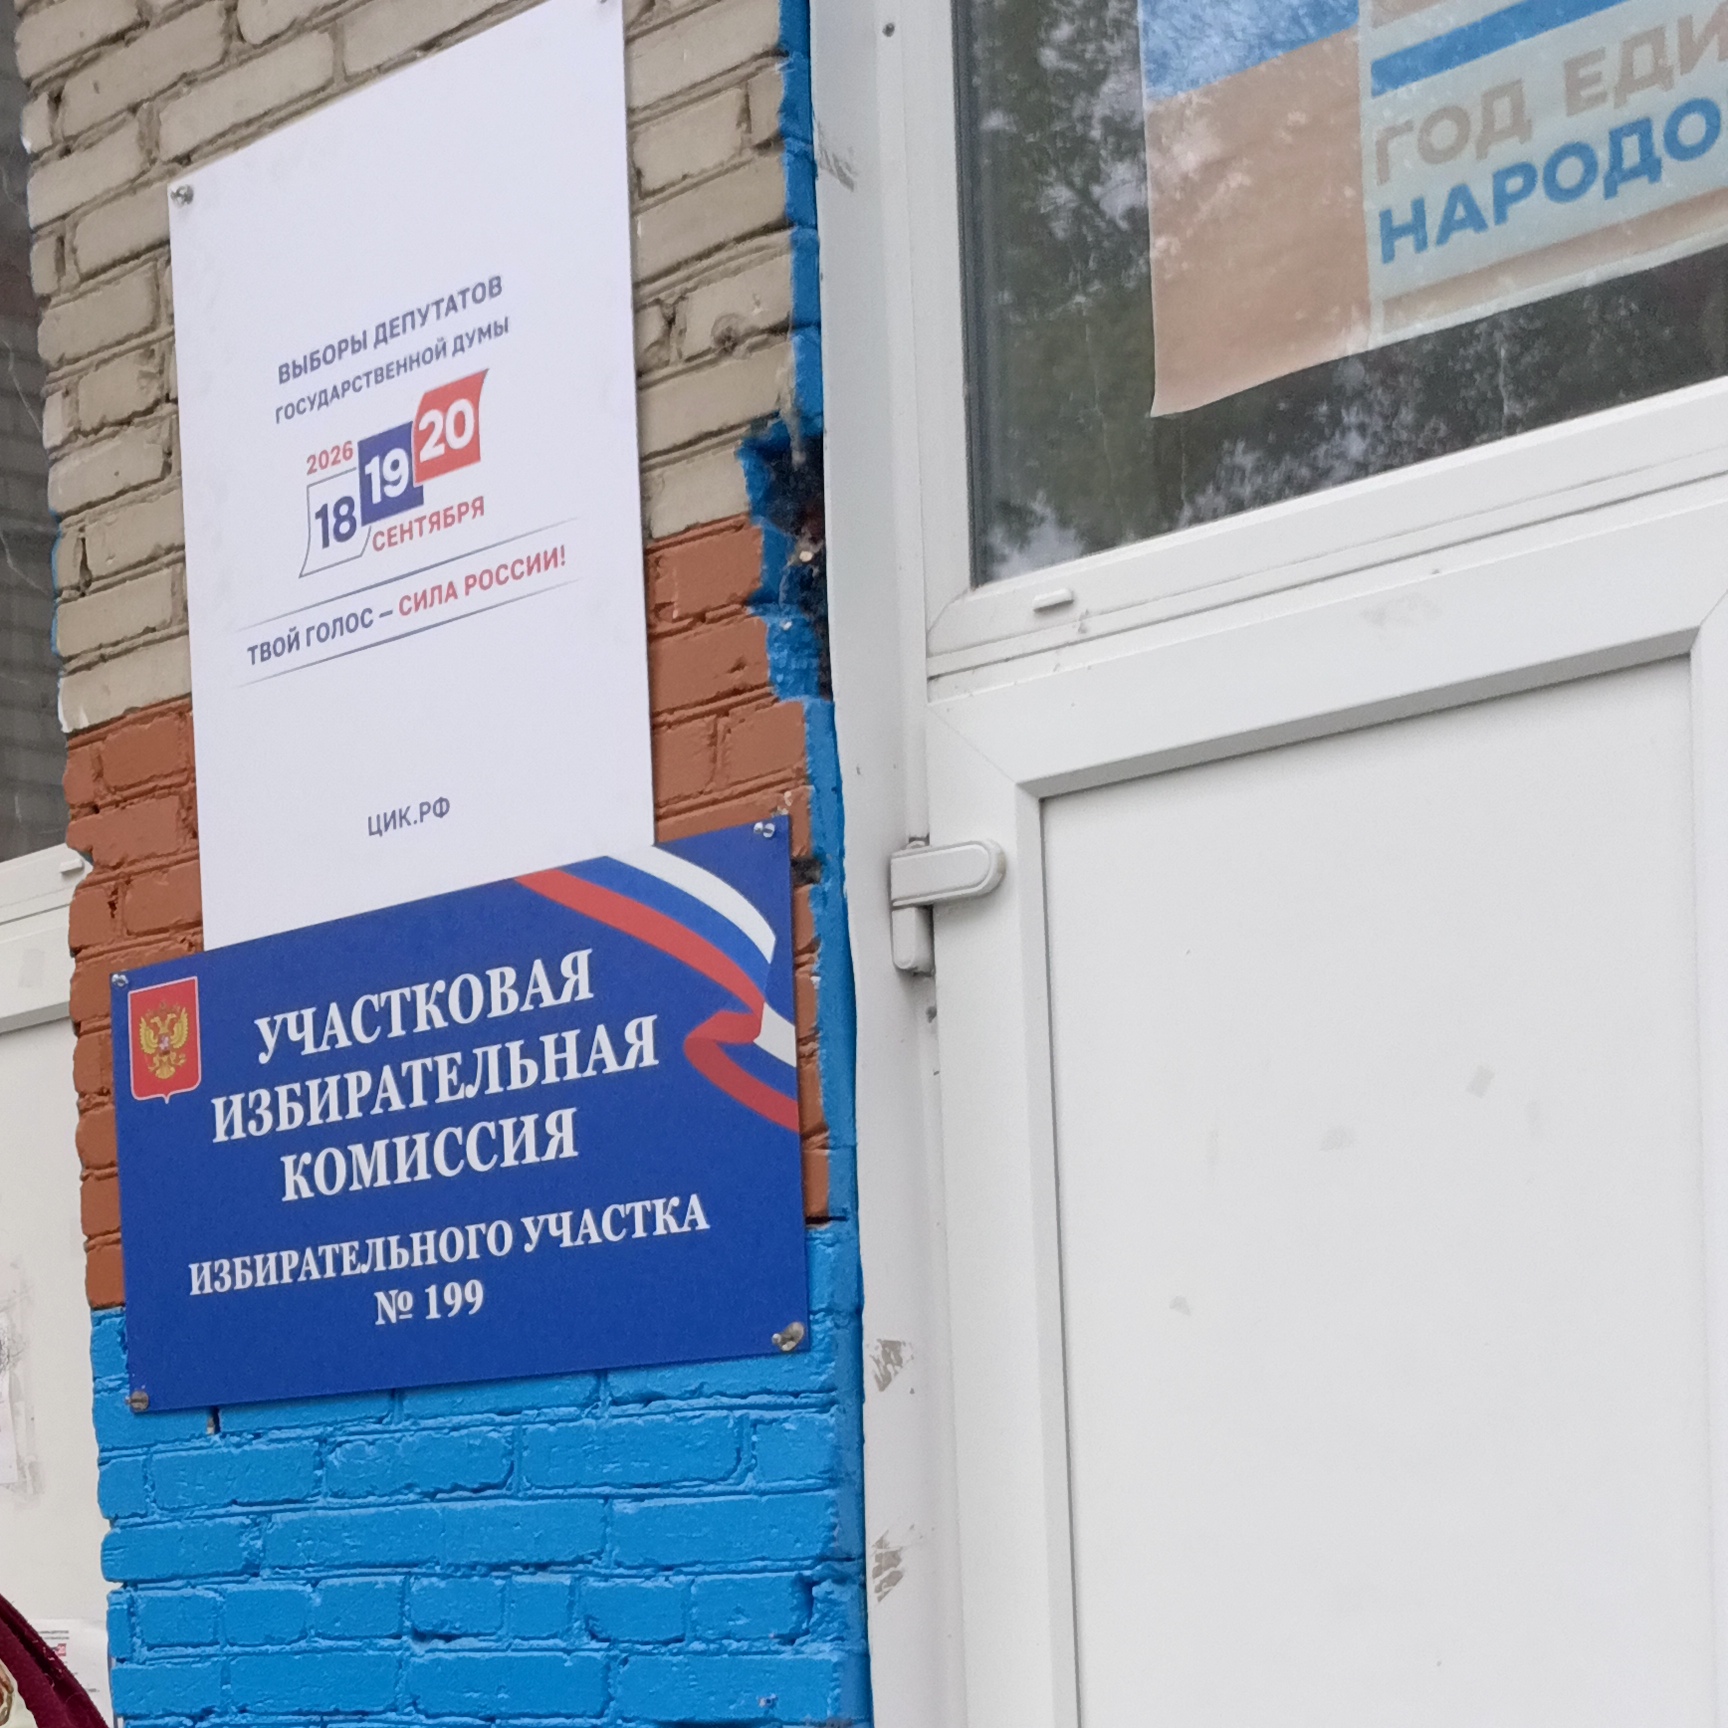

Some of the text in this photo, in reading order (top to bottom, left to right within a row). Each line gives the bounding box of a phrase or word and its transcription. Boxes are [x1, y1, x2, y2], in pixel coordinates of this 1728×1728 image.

[1375, 78, 1532, 187] ГОД
[1379, 97, 1721, 264] НАРОДО
[275, 316, 509, 424] ГОСУДАРСТВЕННОЙ ДУМЫ
[278, 275, 503, 385] ВЫБОРЫ ДЕПУТАТОВ
[306, 440, 354, 475] 2026
[314, 398, 474, 550] 18 19 20
[372, 495, 485, 552] СЕНТЯБРЯ
[247, 626, 300, 666] ТВОЙ
[306, 607, 374, 647] ГОЛОС
[398, 580, 458, 617] СИЛА
[464, 544, 566, 596] РОССИИ!
[367, 795, 450, 838] ЦИК.РФ
[255, 947, 594, 1064] УЧАСТКОВАЯ
[211, 1014, 659, 1143] ИЗБИРАТЕЛЬНАЯ
[281, 1107, 578, 1202] КОМИССИЯ
[188, 1193, 710, 1296] ИЗБИРАТЕЛЬНОГО УЧАСТКА
[374, 1279, 484, 1326] № 199
